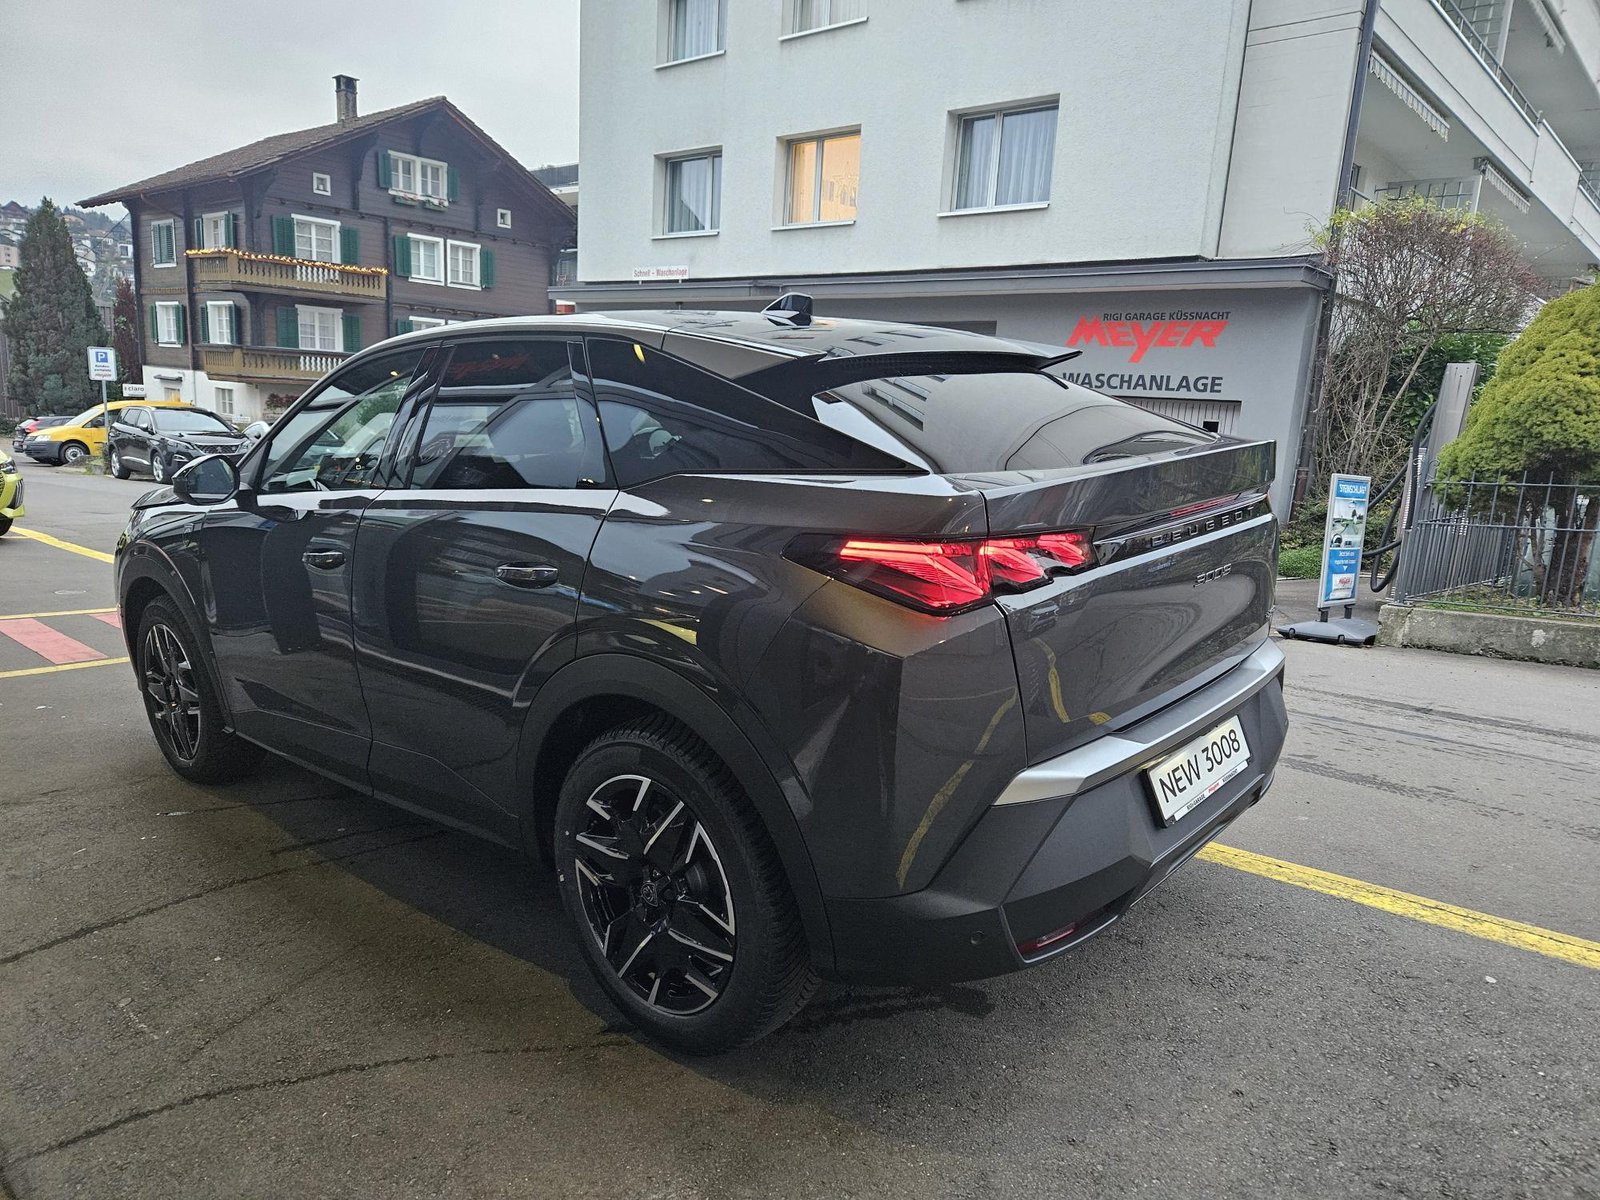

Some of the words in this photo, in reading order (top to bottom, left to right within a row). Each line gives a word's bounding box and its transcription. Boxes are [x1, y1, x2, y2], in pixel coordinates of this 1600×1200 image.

[1103, 313, 1122, 321] RIGI
[1125, 312, 1166, 321] GARAGE
[1168, 310, 1231, 320] KÜSSNACHT
[1065, 314, 1229, 364] MEYER
[1062, 372, 1223, 393] WASCHANLAGE
[1152, 506, 1254, 547] PEUGEOT
[1158, 754, 1201, 803] NEW
[1201, 729, 1240, 773] 3008
